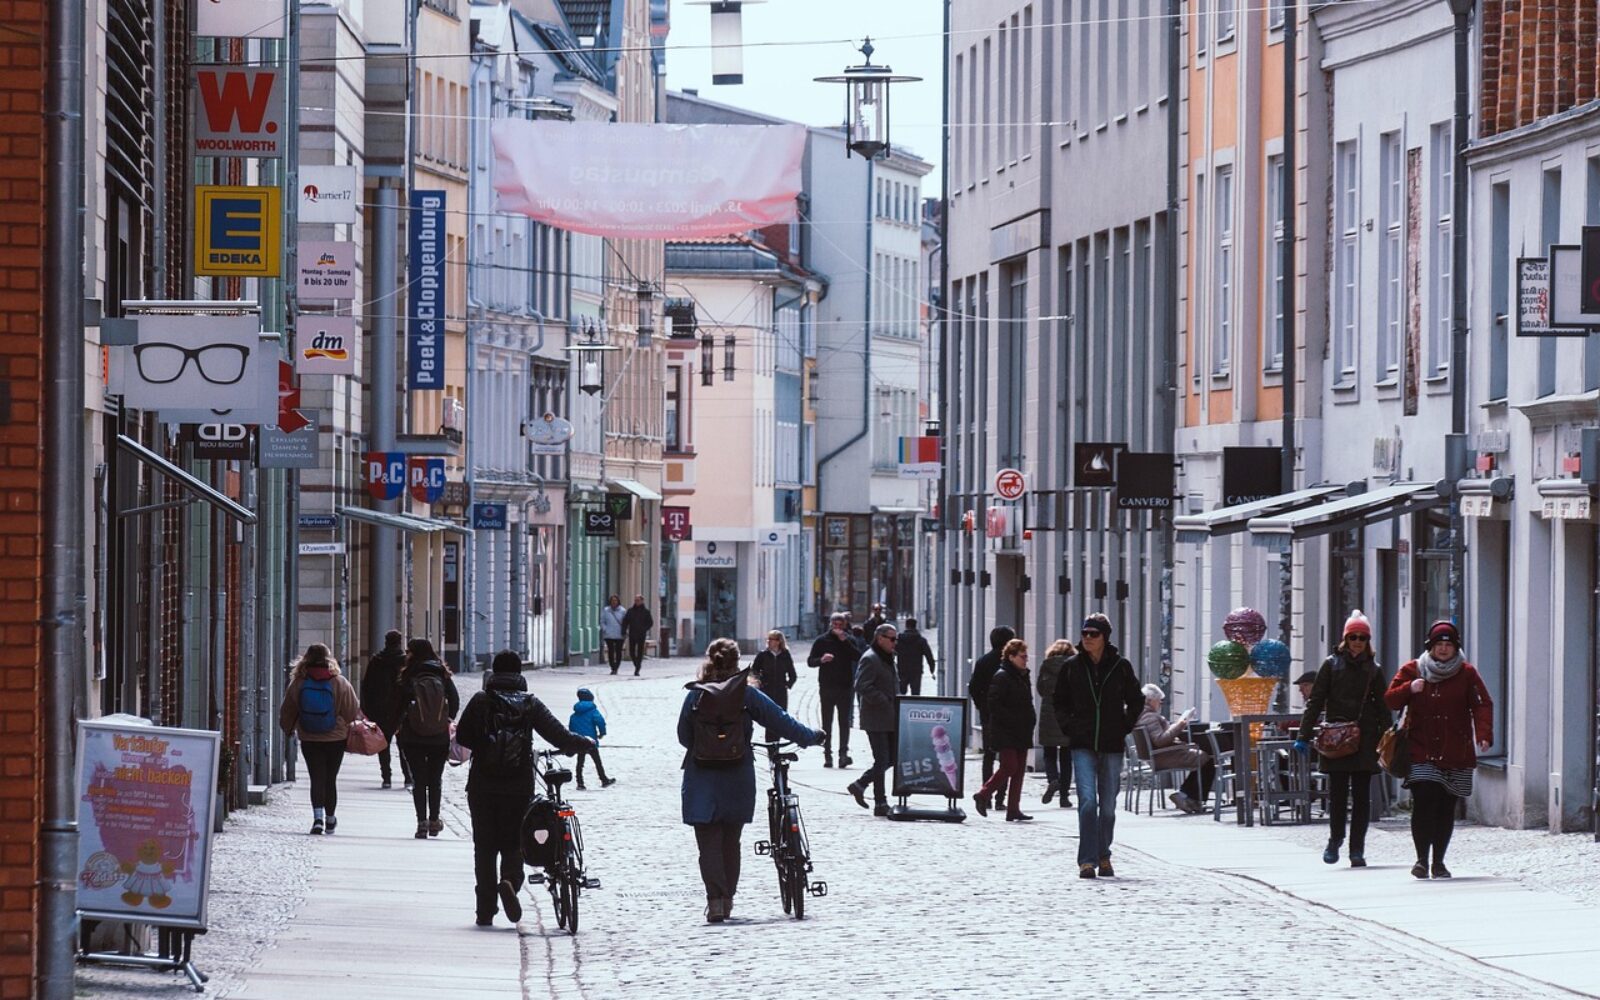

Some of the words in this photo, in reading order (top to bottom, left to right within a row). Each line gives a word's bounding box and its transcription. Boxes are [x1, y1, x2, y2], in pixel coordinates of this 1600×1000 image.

[197, 139, 276, 151] WOOLWORTH
[210, 198, 262, 249] E
[209, 254, 262, 264] EDEKA
[334, 278, 348, 286] Uhr
[312, 331, 343, 349] dm
[369, 461, 404, 484] P&C
[411, 466, 443, 488] P&C
[1119, 497, 1170, 507] CANVERO
[476, 519, 502, 528] Apollo
[902, 758, 933, 776] EIS
[147, 769, 192, 786] backen!
